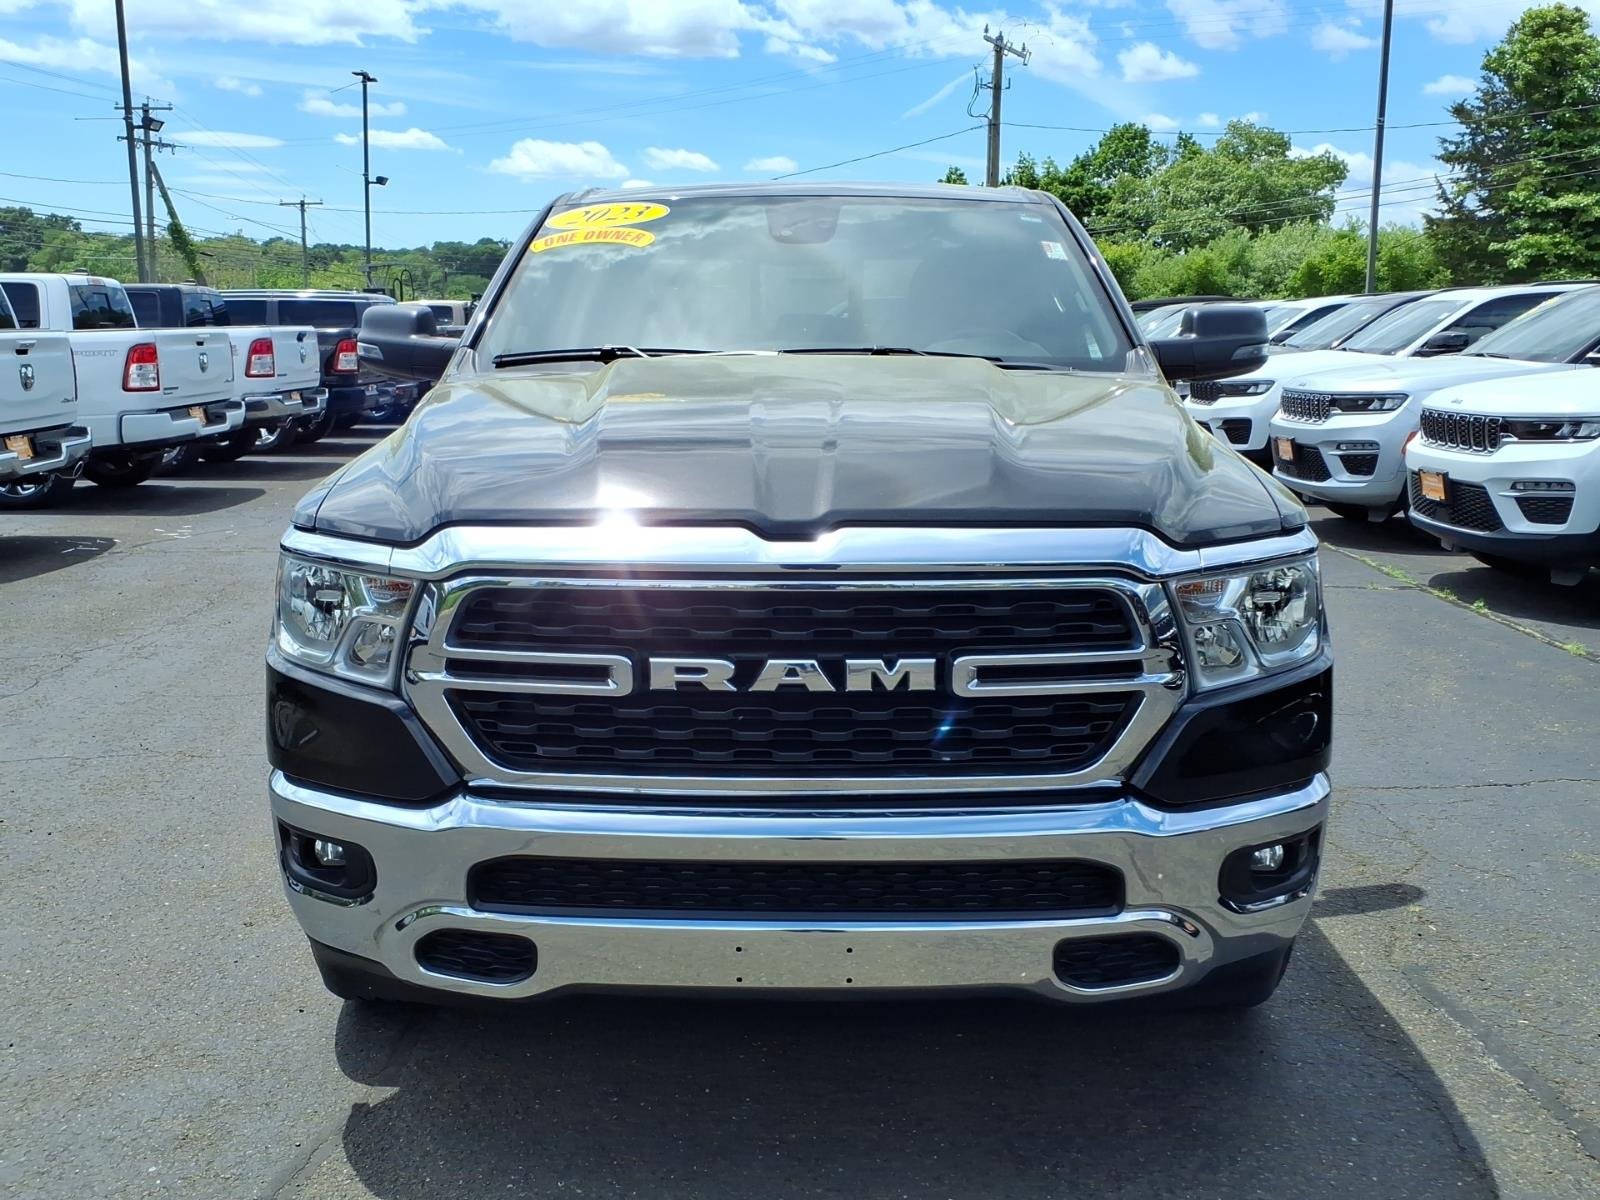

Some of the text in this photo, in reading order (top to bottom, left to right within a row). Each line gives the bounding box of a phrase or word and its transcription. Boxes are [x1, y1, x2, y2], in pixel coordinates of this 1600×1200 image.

[563, 205, 652, 225] 2023
[543, 229, 646, 247] ONE OWNER
[649, 657, 937, 692] RAM
